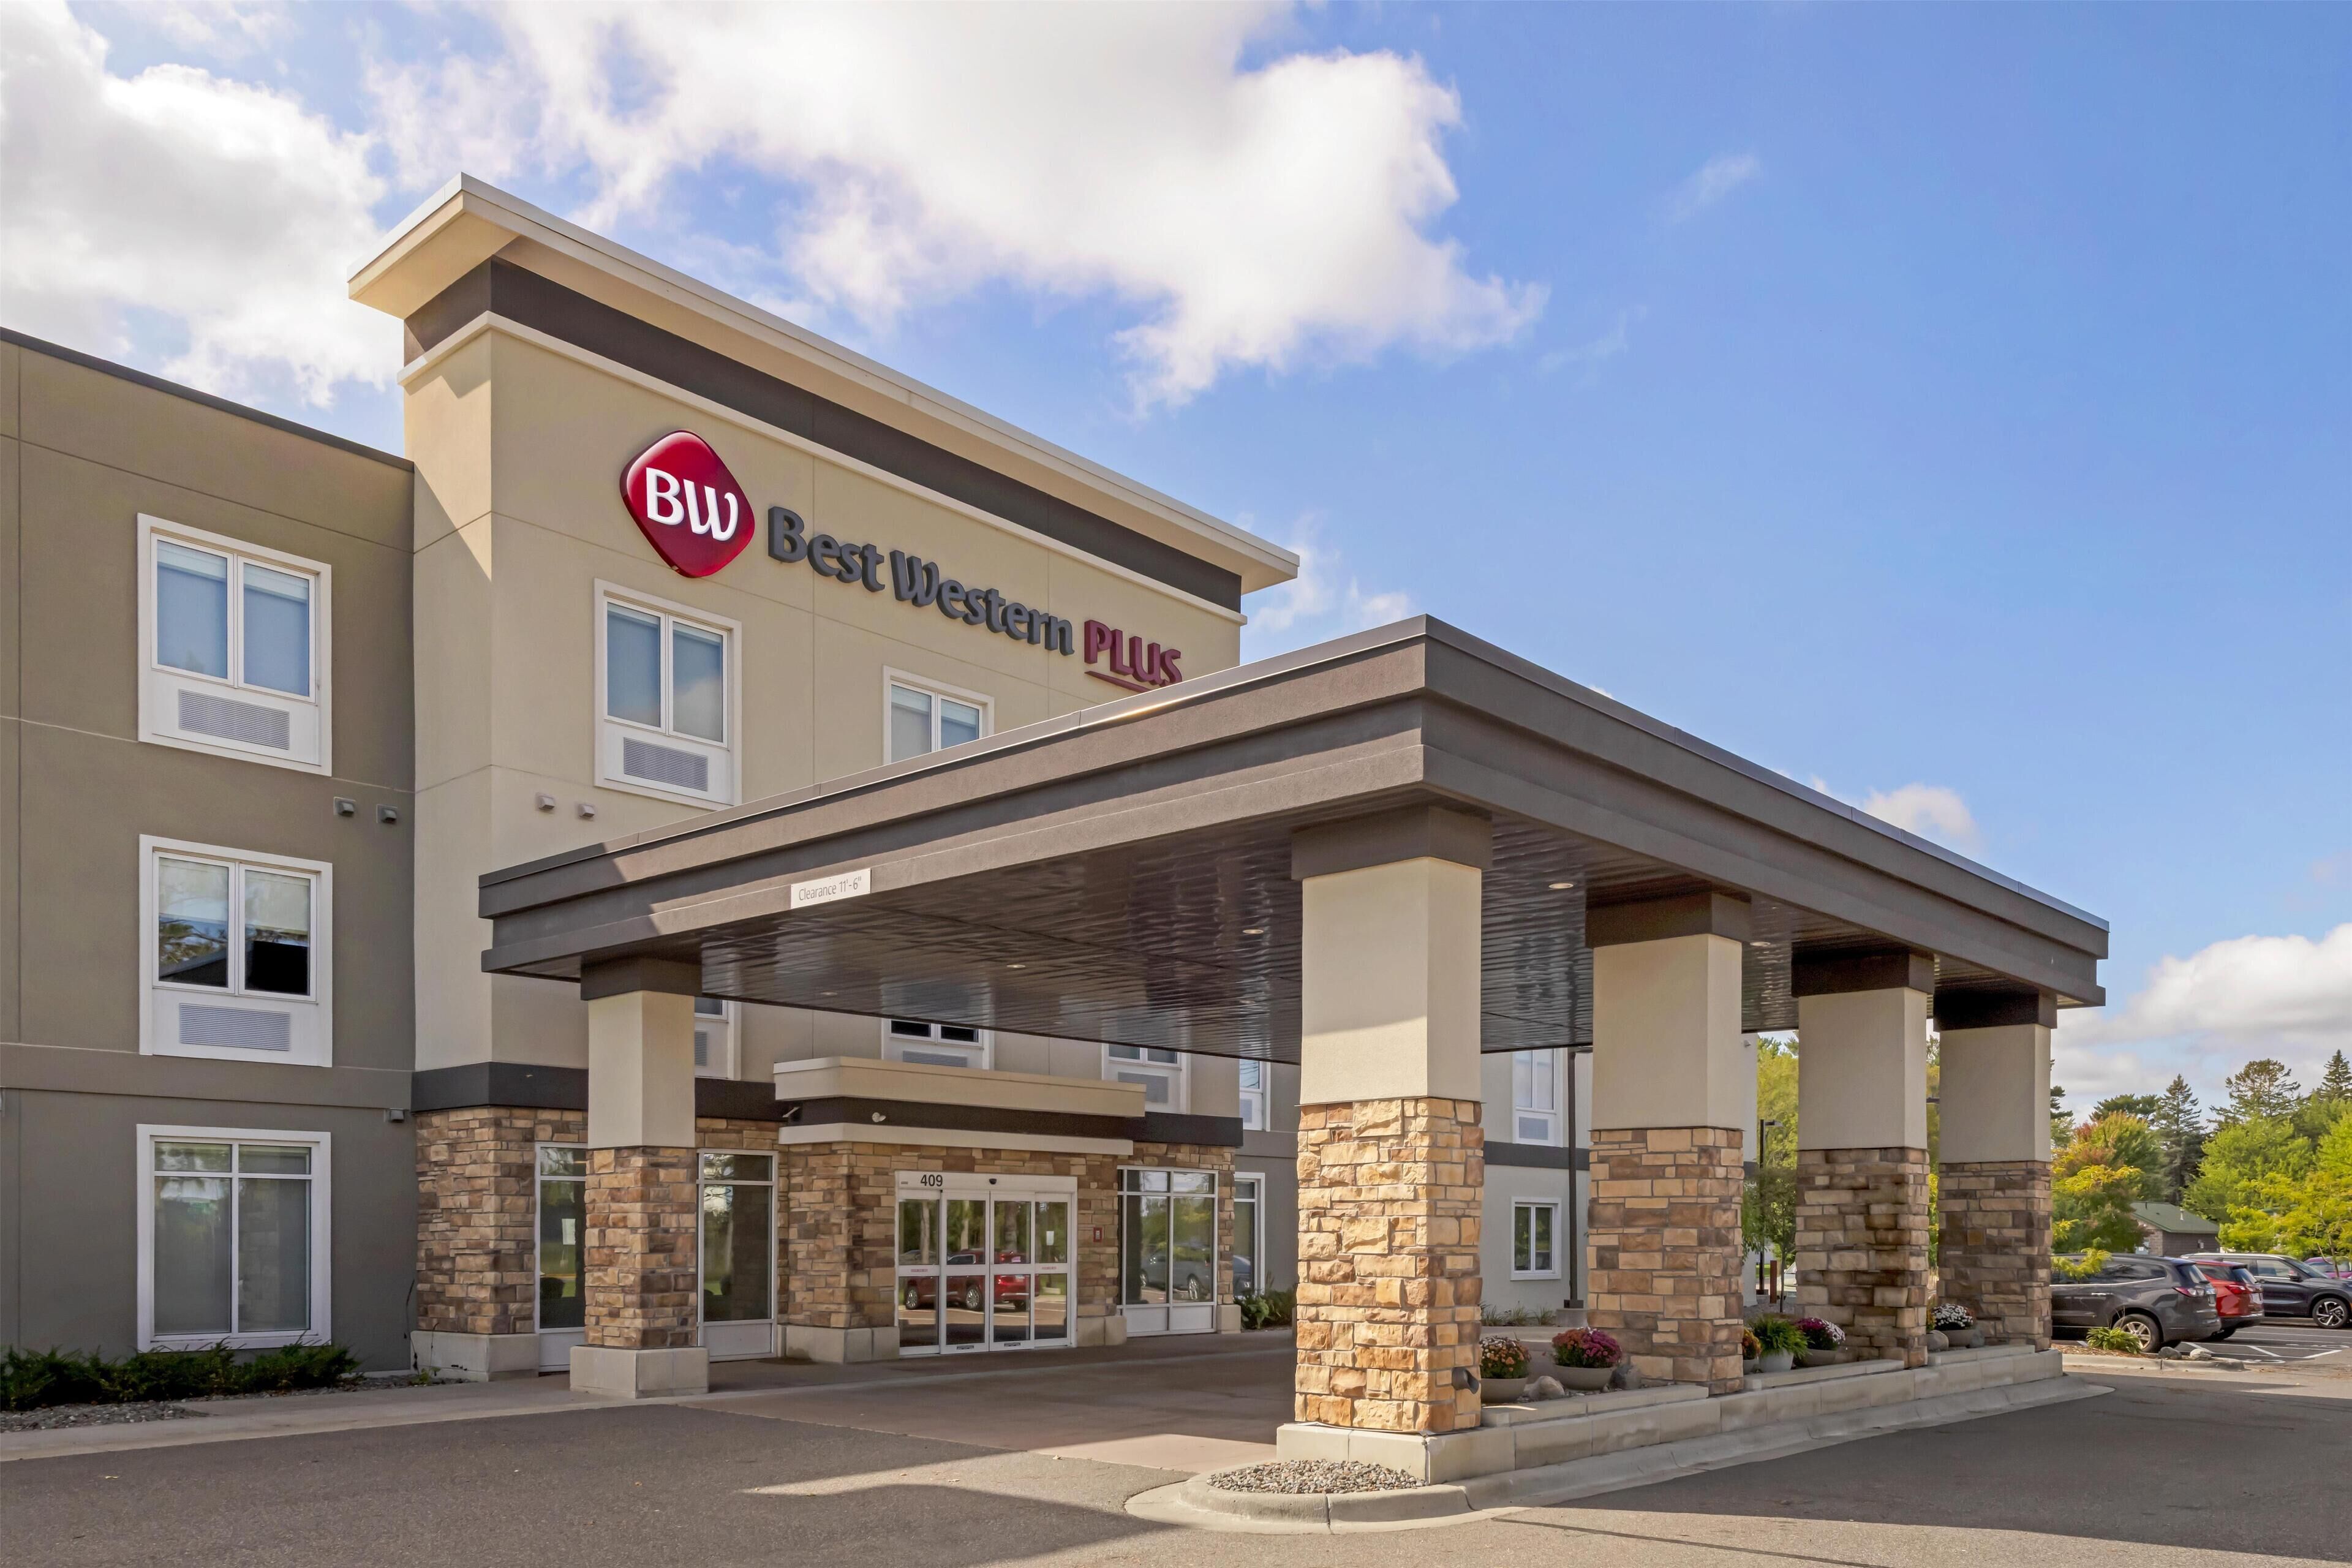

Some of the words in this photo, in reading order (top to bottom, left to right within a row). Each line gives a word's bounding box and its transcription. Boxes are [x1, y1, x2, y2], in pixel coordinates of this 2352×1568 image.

[646, 467, 738, 541] BW
[768, 506, 885, 592] Best
[889, 549, 1075, 656] Western
[1084, 619, 1183, 687] PLUS
[799, 884, 837, 901] Clearance
[921, 1174, 943, 1187] 409
